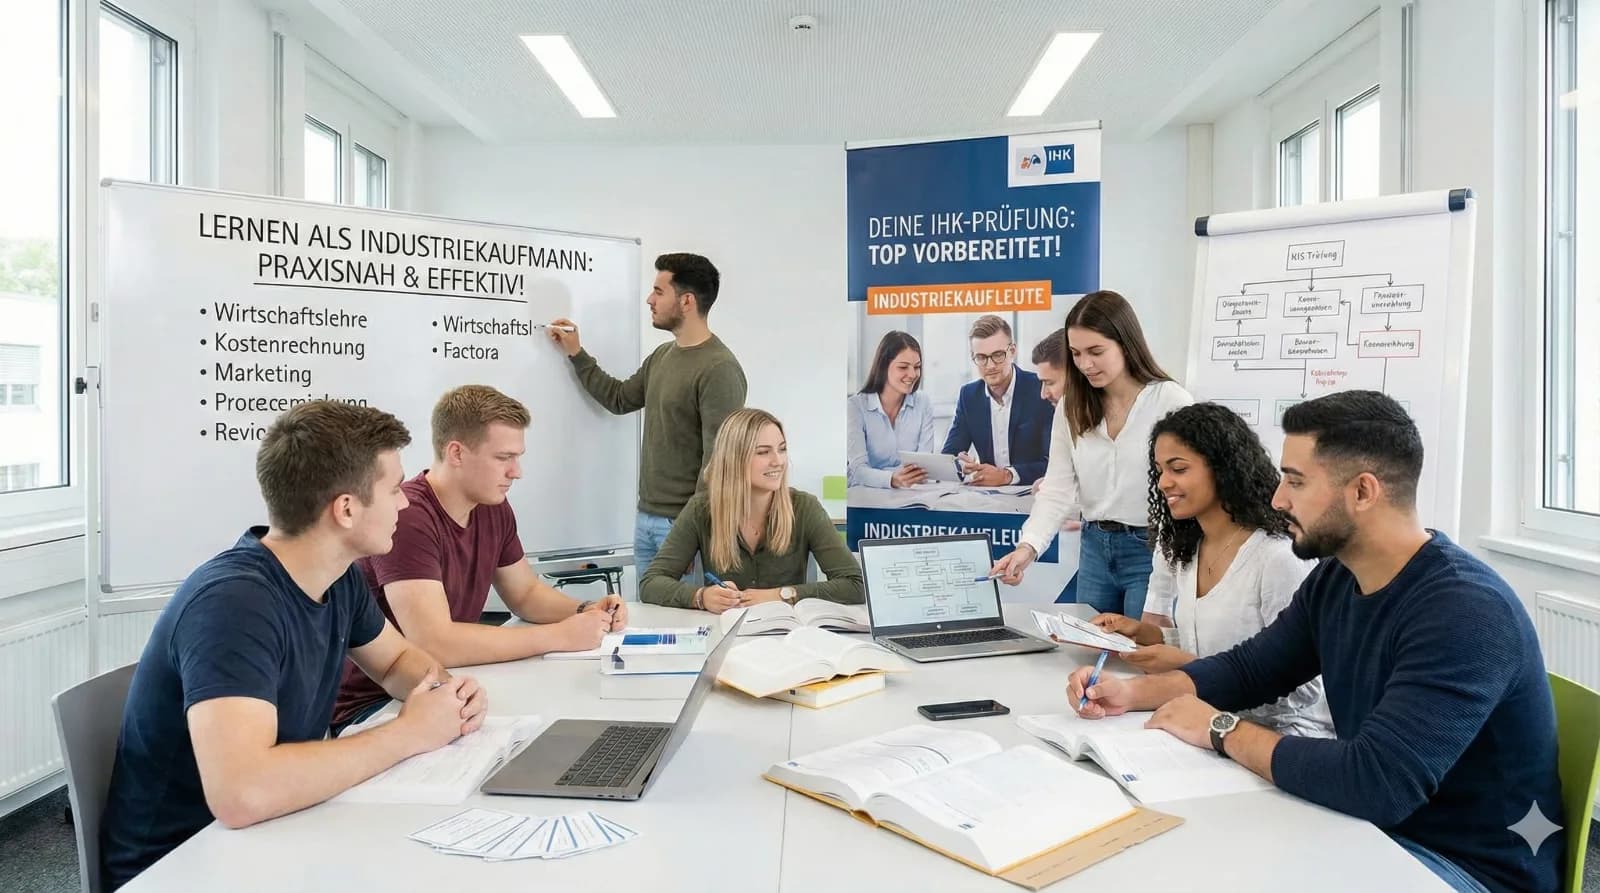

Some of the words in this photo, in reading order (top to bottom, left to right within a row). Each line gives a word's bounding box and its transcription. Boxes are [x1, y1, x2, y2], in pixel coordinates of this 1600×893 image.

[1048, 148, 1072, 161] IHK
[869, 214, 925, 239] DEINE
[931, 204, 1076, 236] IHK-PRÜFUNG:
[199, 212, 299, 246] LERNEN
[308, 224, 352, 251] ALS
[360, 229, 593, 272] INDUSTRIEKAUFMANN:
[868, 244, 907, 266] TOP
[912, 235, 1062, 264] VORBEREITET!
[257, 253, 396, 287] PRAXISNAH
[403, 265, 419, 289] &
[428, 266, 525, 297] EFFEKTIV!
[874, 287, 1044, 309] INDUSTRIEKAUFLEUTE
[214, 302, 368, 329] Wirtschaftslehre
[215, 332, 365, 361] Kostenrechnung
[444, 341, 499, 360] Factora
[215, 362, 312, 388] Marketing
